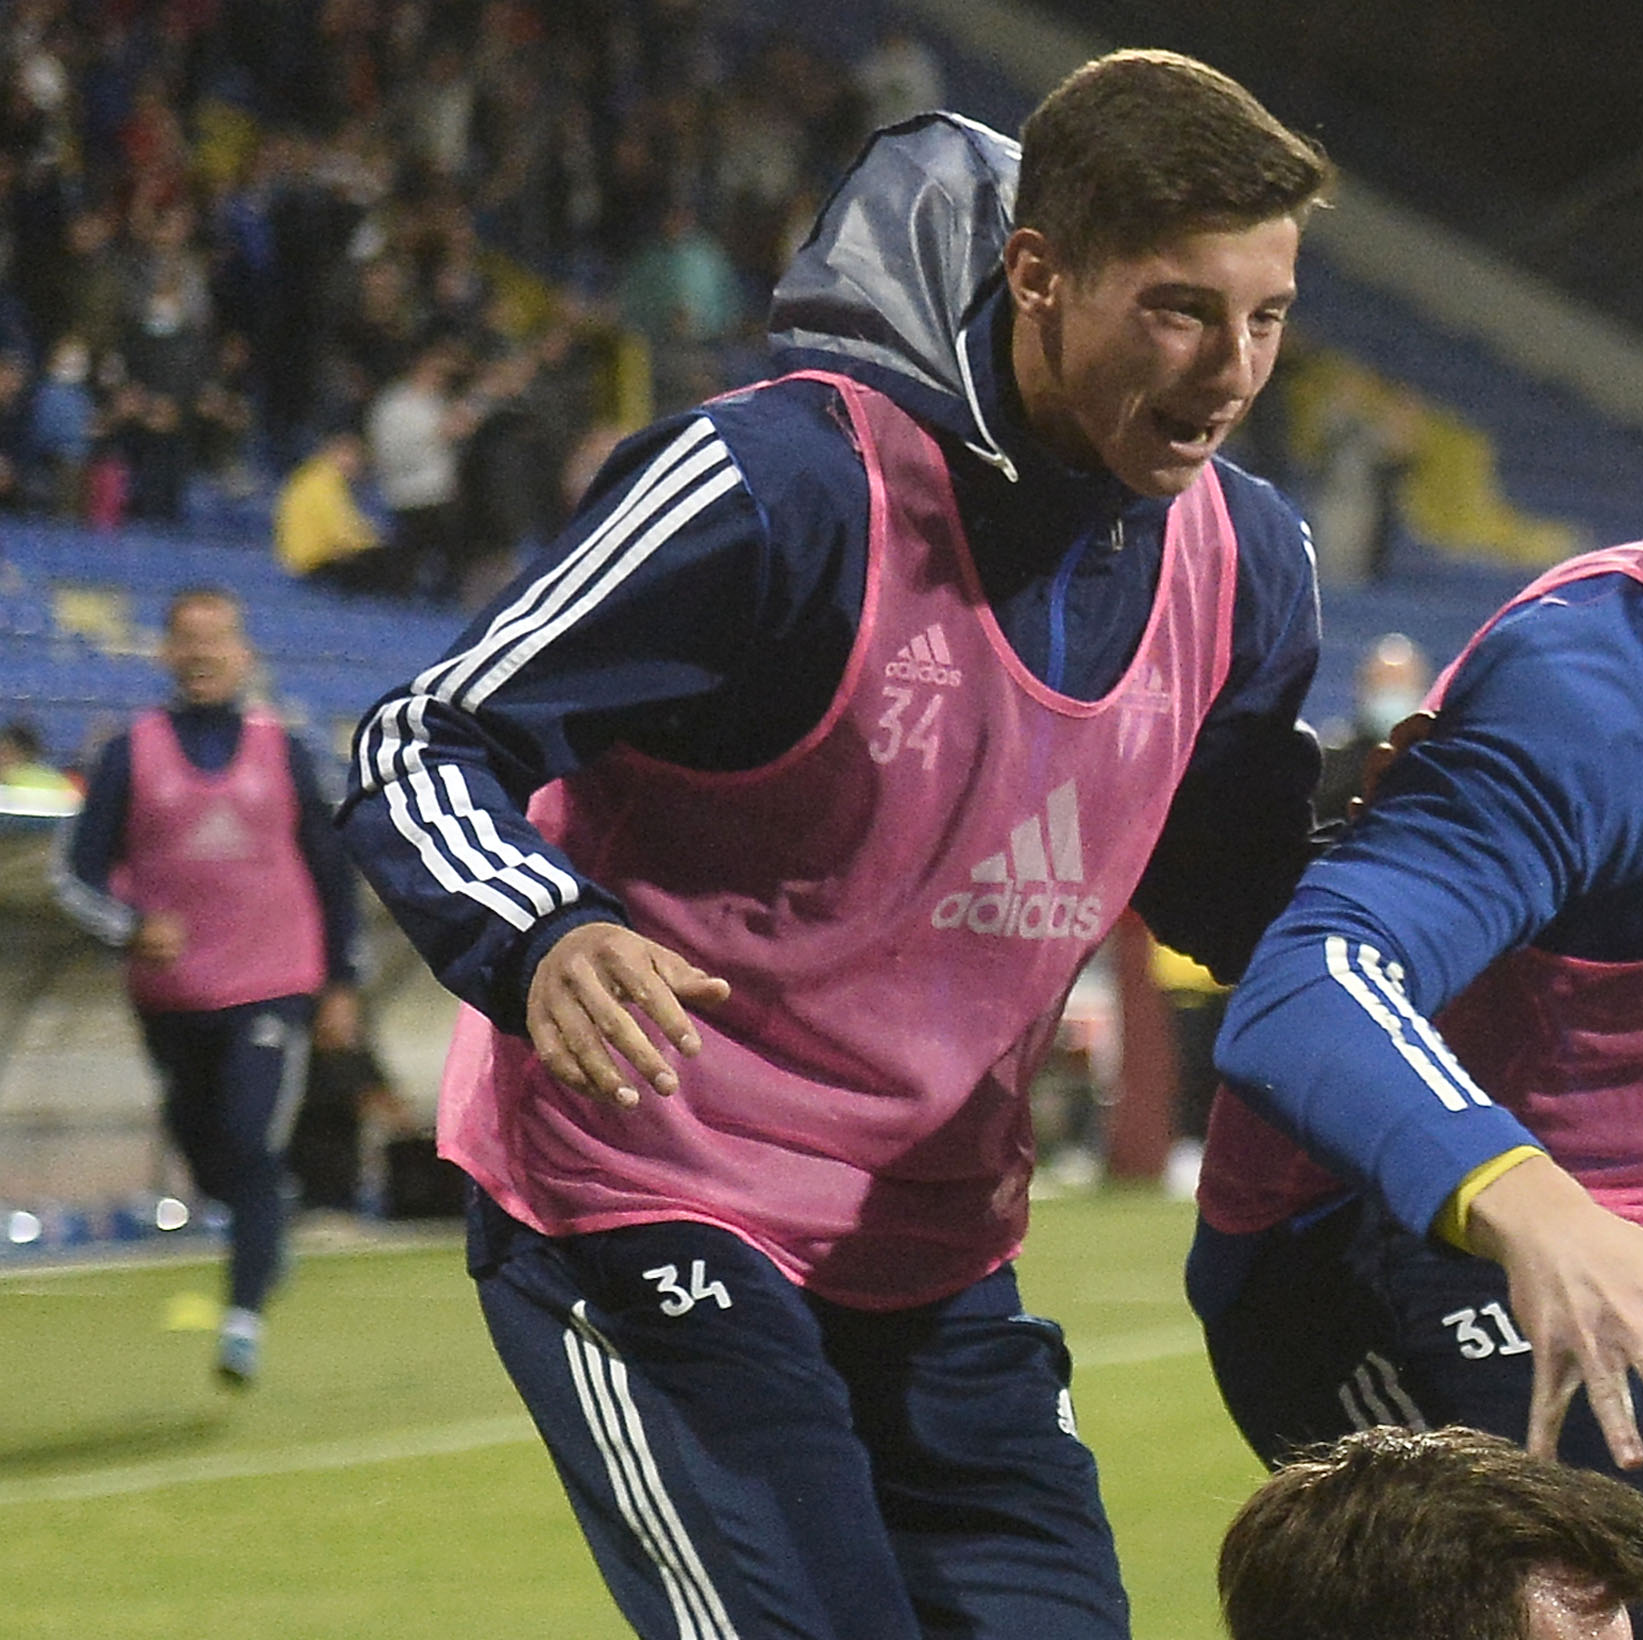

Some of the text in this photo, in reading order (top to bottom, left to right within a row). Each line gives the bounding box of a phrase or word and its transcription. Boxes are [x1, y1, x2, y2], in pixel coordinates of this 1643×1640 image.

[884, 660, 962, 687] adidas
[869, 686, 943, 770] 34
[931, 878, 1101, 940] adidas
[642, 1259, 733, 1317] 34
[1441, 1302, 1533, 1359] 31
